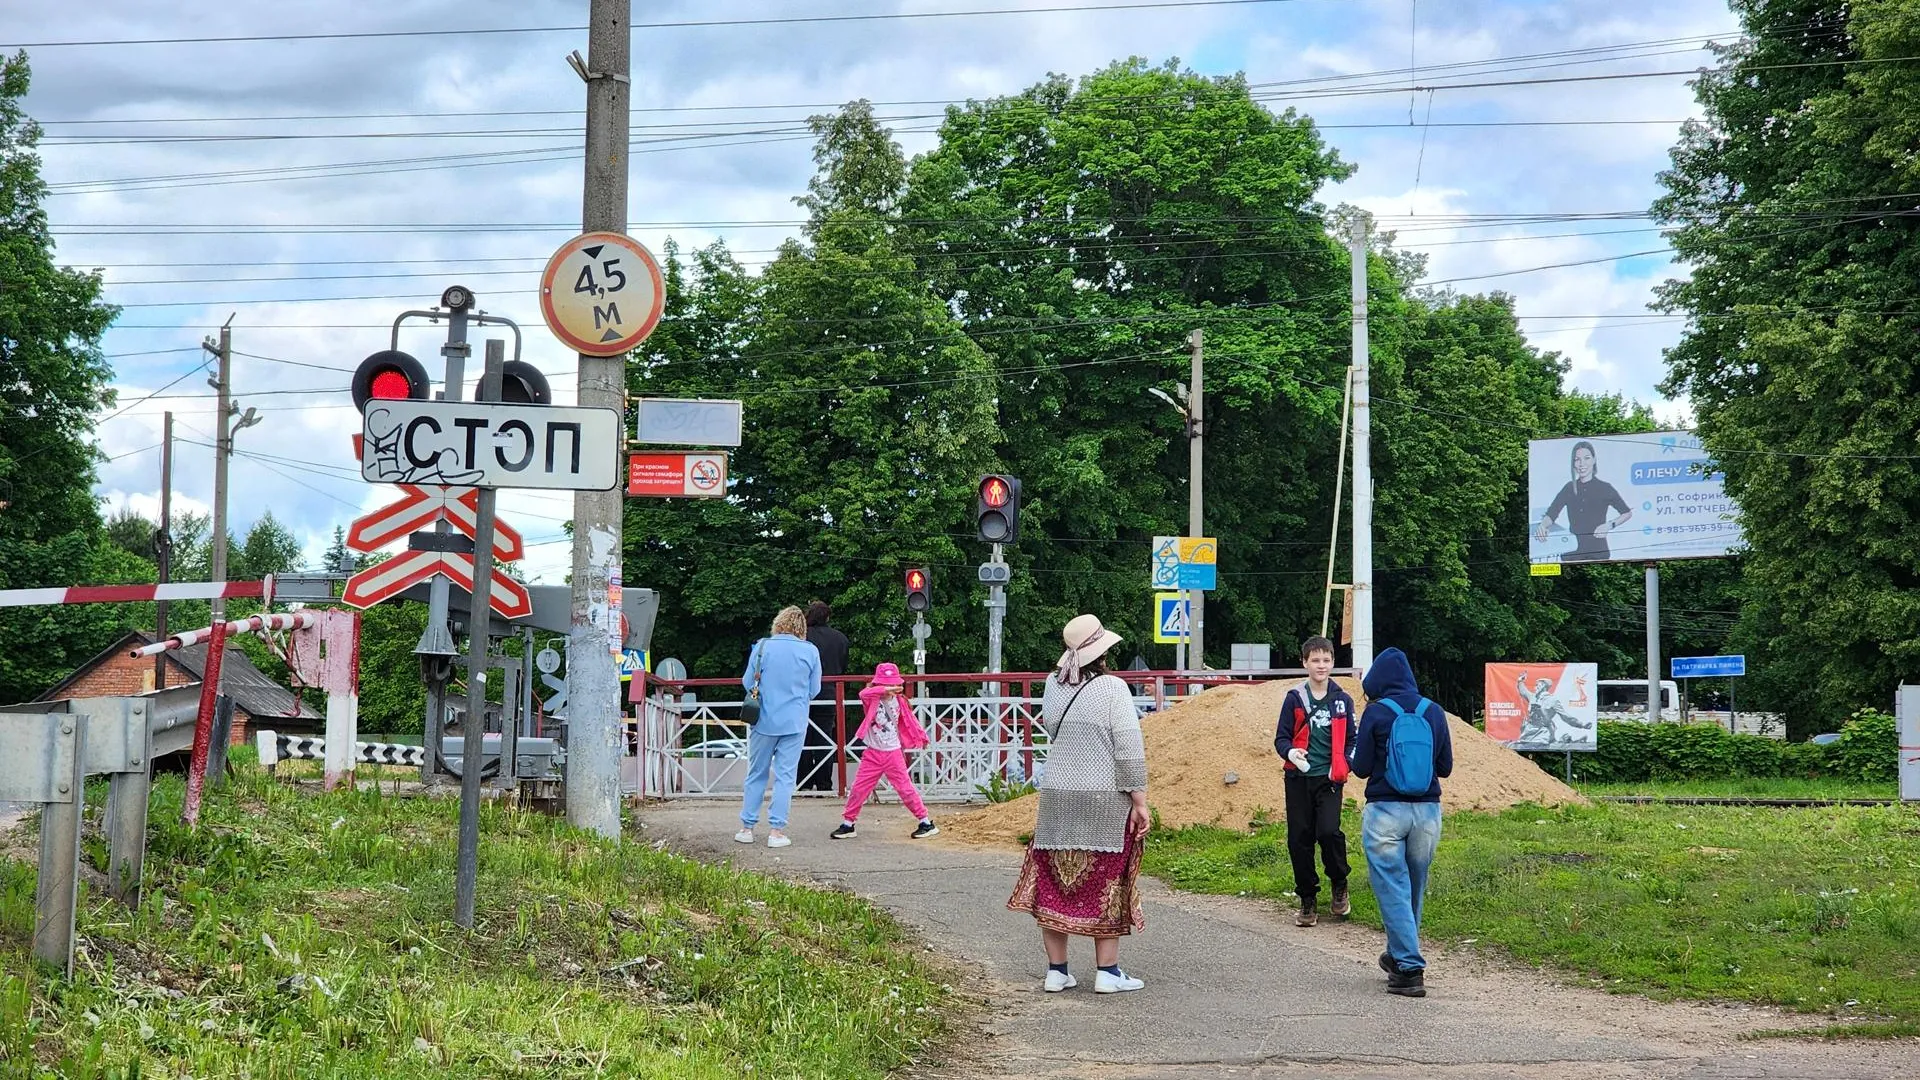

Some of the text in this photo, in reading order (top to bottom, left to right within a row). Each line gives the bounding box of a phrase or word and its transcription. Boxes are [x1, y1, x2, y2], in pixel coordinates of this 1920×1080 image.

[574, 259, 626, 299] 4,5
[404, 415, 581, 474] СТОП
[1634, 469, 1643, 479] Я
[1646, 467, 1682, 478] ЛЕЧУ
